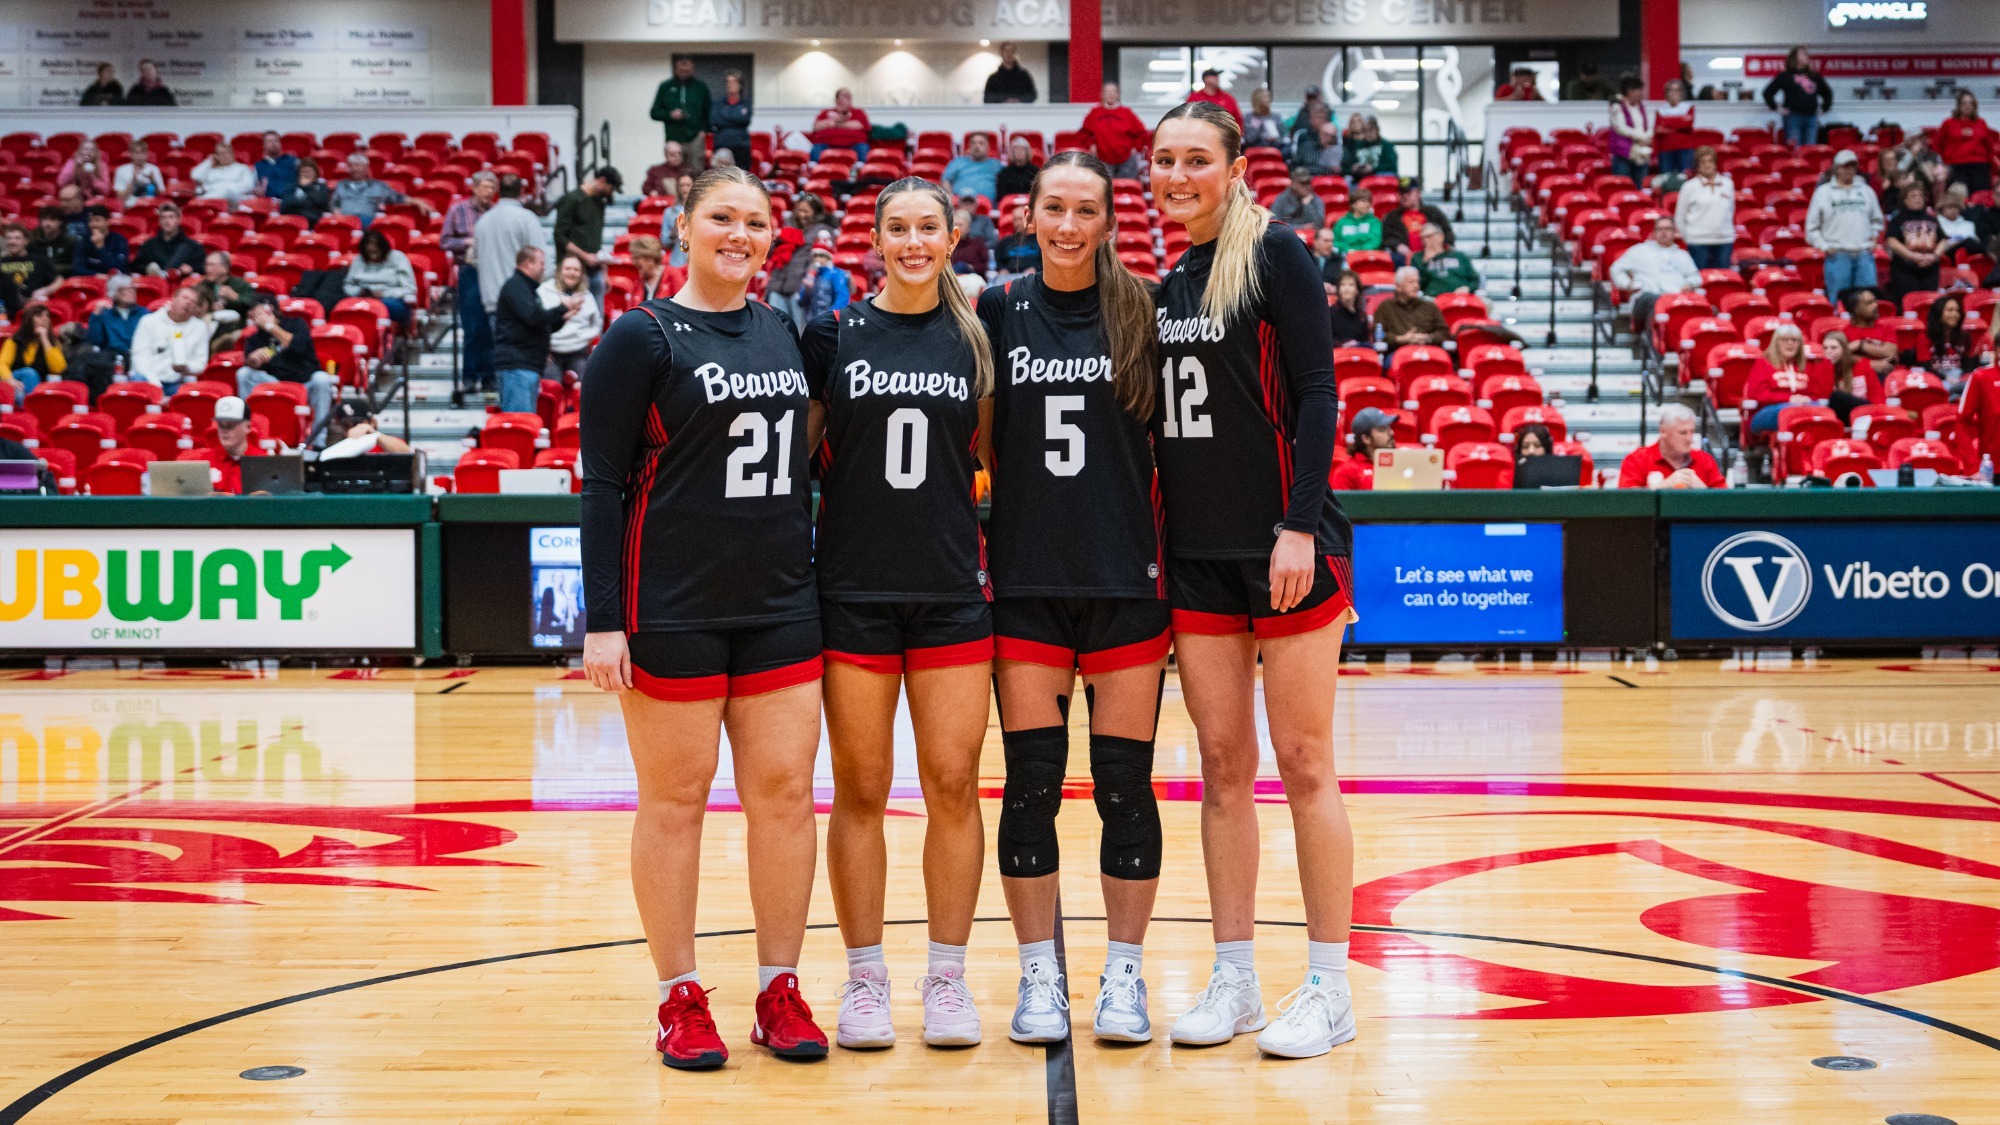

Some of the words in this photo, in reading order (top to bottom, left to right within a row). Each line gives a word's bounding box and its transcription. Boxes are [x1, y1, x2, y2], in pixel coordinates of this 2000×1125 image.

[647, 0, 747, 27] DEAN
[992, 0, 1182, 26] ACAEMIC
[1196, 0, 1366, 26] SUCCESS
[1379, 0, 1528, 26] CENTER
[1891, 58, 1909, 70] OF
[845, 359, 970, 402] Beavers
[1008, 346, 1116, 386] Beaver
[1162, 356, 1214, 438] 12
[725, 409, 795, 499] 21
[885, 407, 929, 490] 0
[1045, 395, 1086, 477] 5
[538, 534, 581, 548] COR
[1395, 565, 1434, 584] Let's
[1436, 569, 1465, 584] see
[1467, 565, 1507, 583] what
[1509, 568, 1534, 583] we
[1723, 556, 1800, 624] V
[1823, 561, 1950, 600] Vibeto
[1403, 592, 1433, 606] can
[1436, 589, 1459, 606] do
[1461, 588, 1534, 611] together.
[90, 626, 112, 640] OF
[115, 626, 162, 640] MINOT
